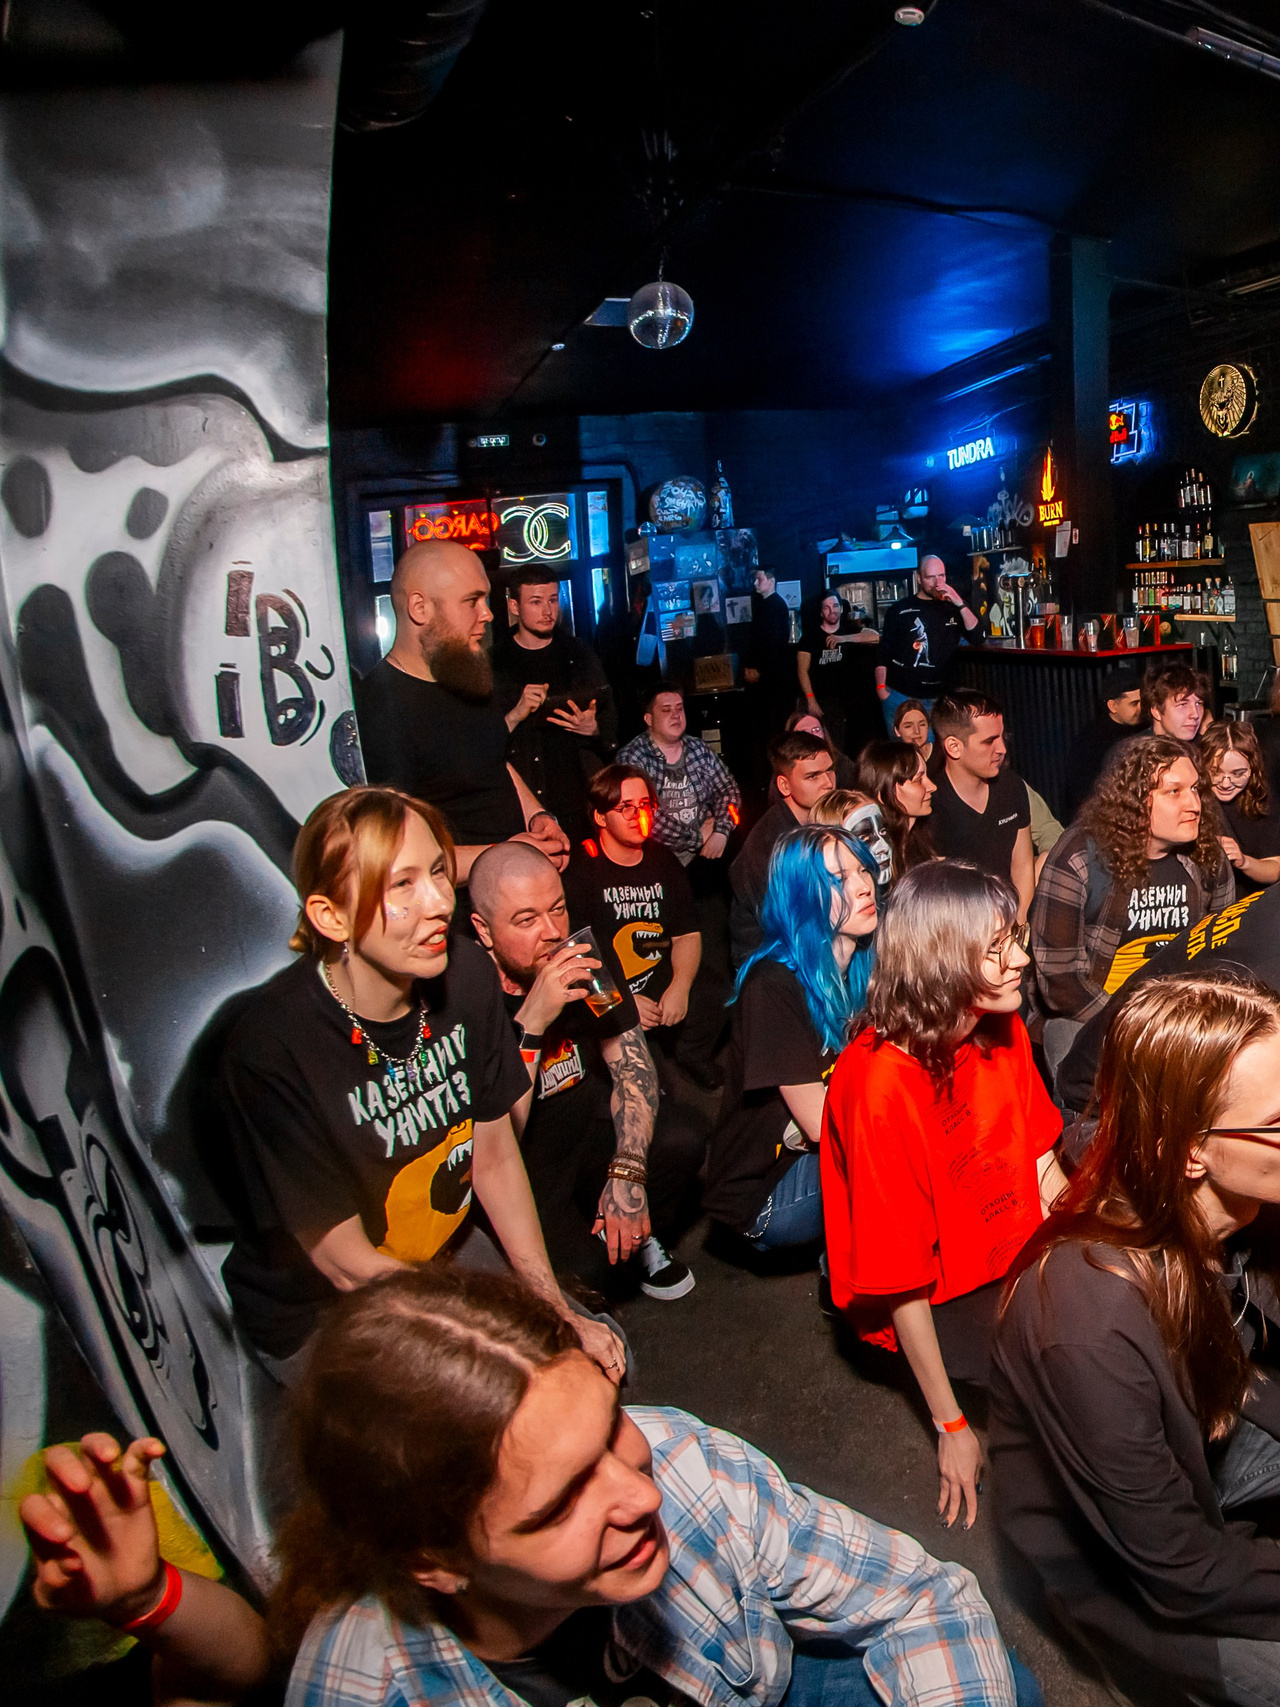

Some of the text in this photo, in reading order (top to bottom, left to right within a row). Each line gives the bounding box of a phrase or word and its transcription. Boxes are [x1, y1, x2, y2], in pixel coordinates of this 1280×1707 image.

[947, 437, 994, 470] TUNDRA
[1039, 501, 1063, 521] BURN
[613, 901, 660, 919] УНИТАЗ
[1127, 906, 1189, 931] УНИТАЗ
[373, 1071, 471, 1158] УНИТАЗ
[980, 1190, 1015, 1216] ОТХОДЫ
[984, 1205, 1011, 1224] КЛАСС
